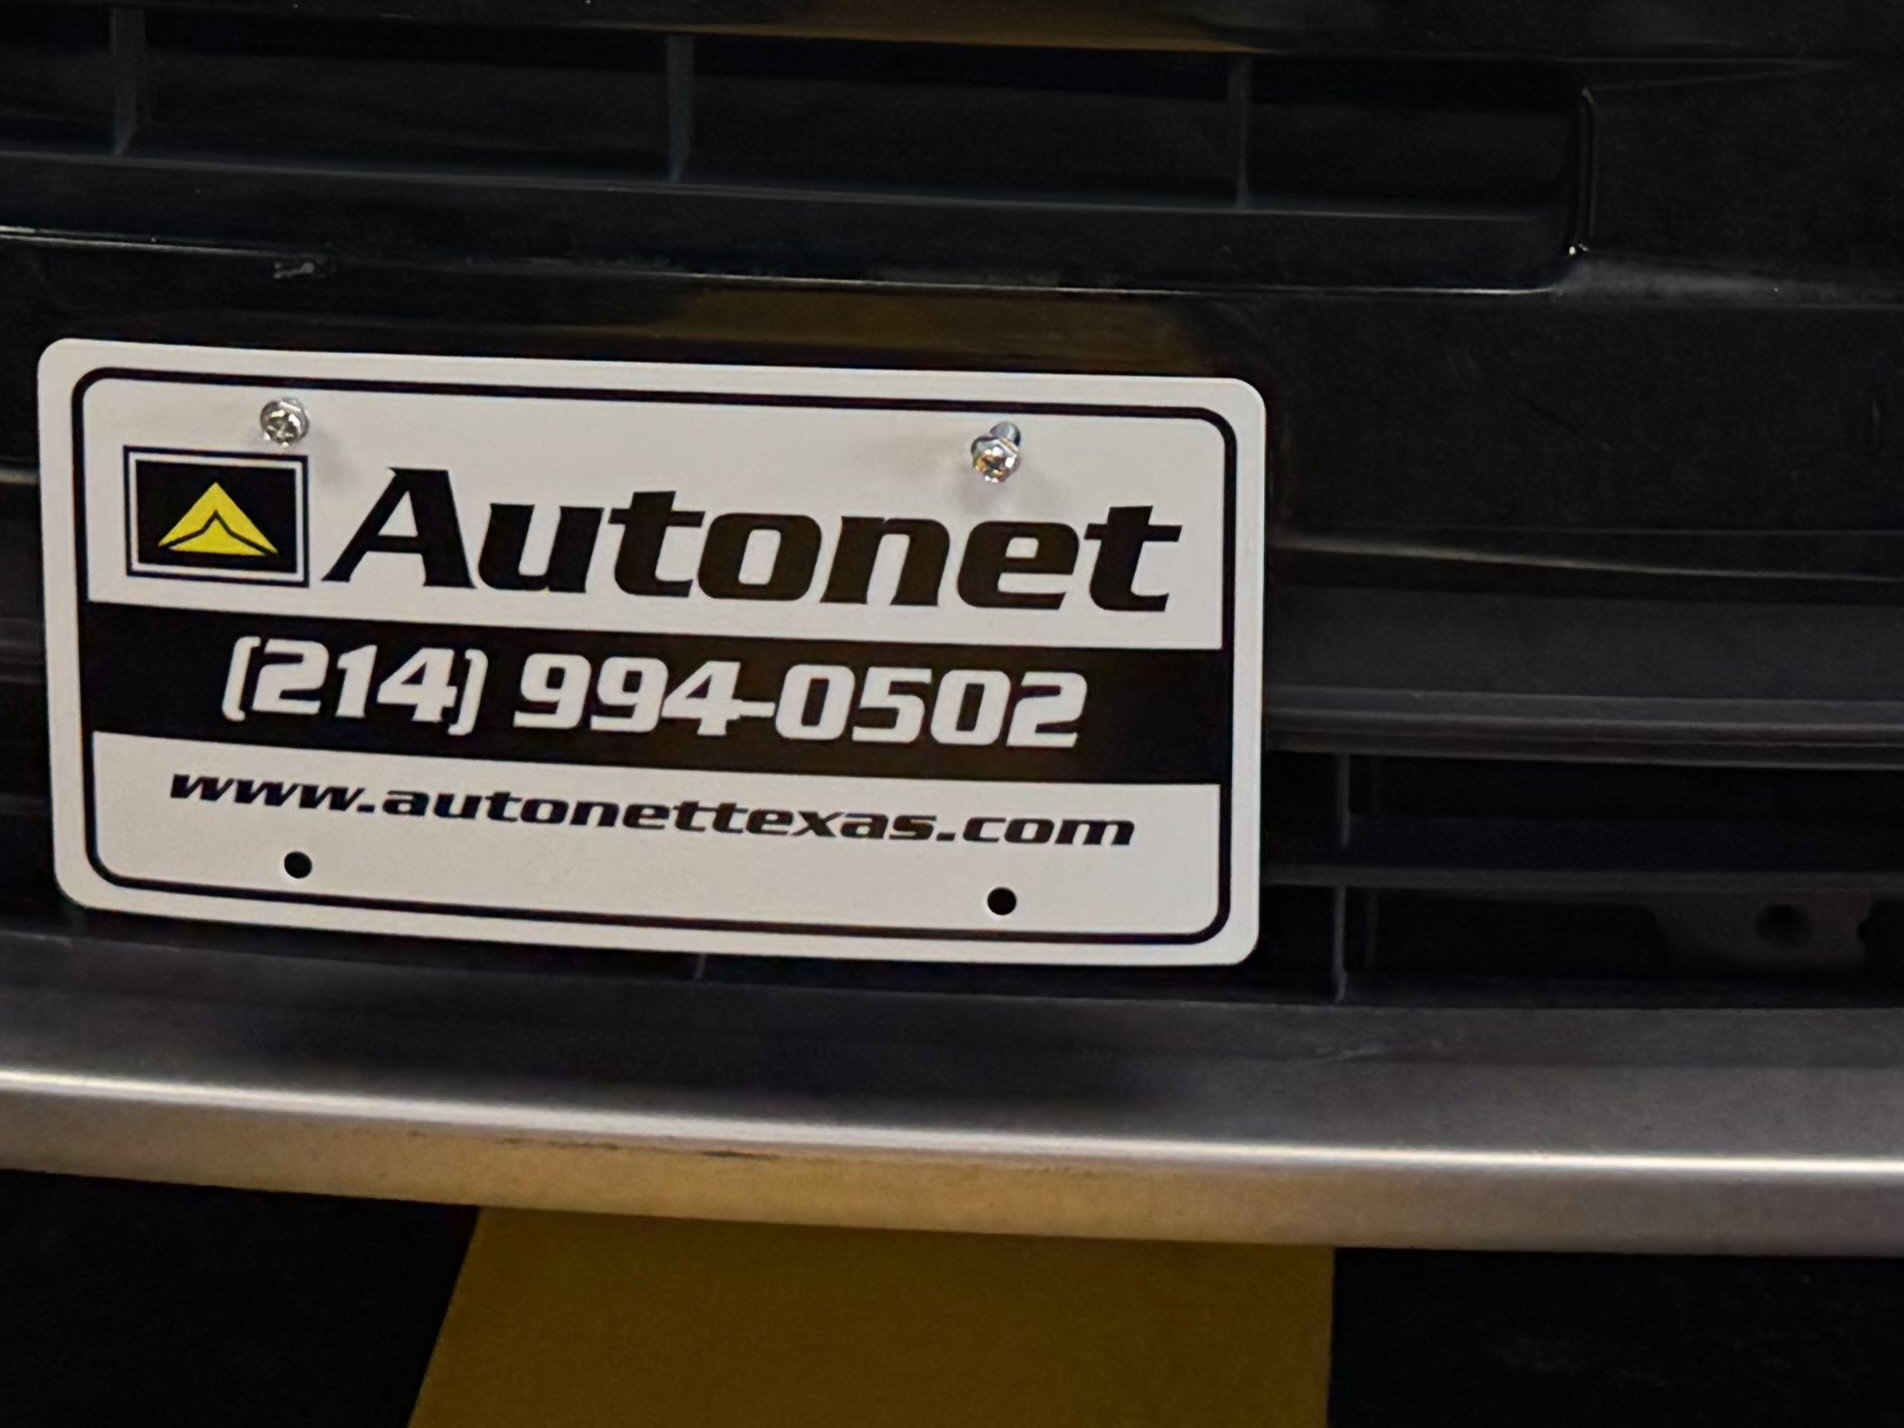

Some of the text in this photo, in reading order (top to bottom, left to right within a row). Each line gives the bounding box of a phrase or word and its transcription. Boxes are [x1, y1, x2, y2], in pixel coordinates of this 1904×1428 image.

[321, 466, 1183, 613] Autonet
[222, 636, 1088, 748] (214) 994-0502
[169, 773, 1135, 846] www.autonettexas.com
